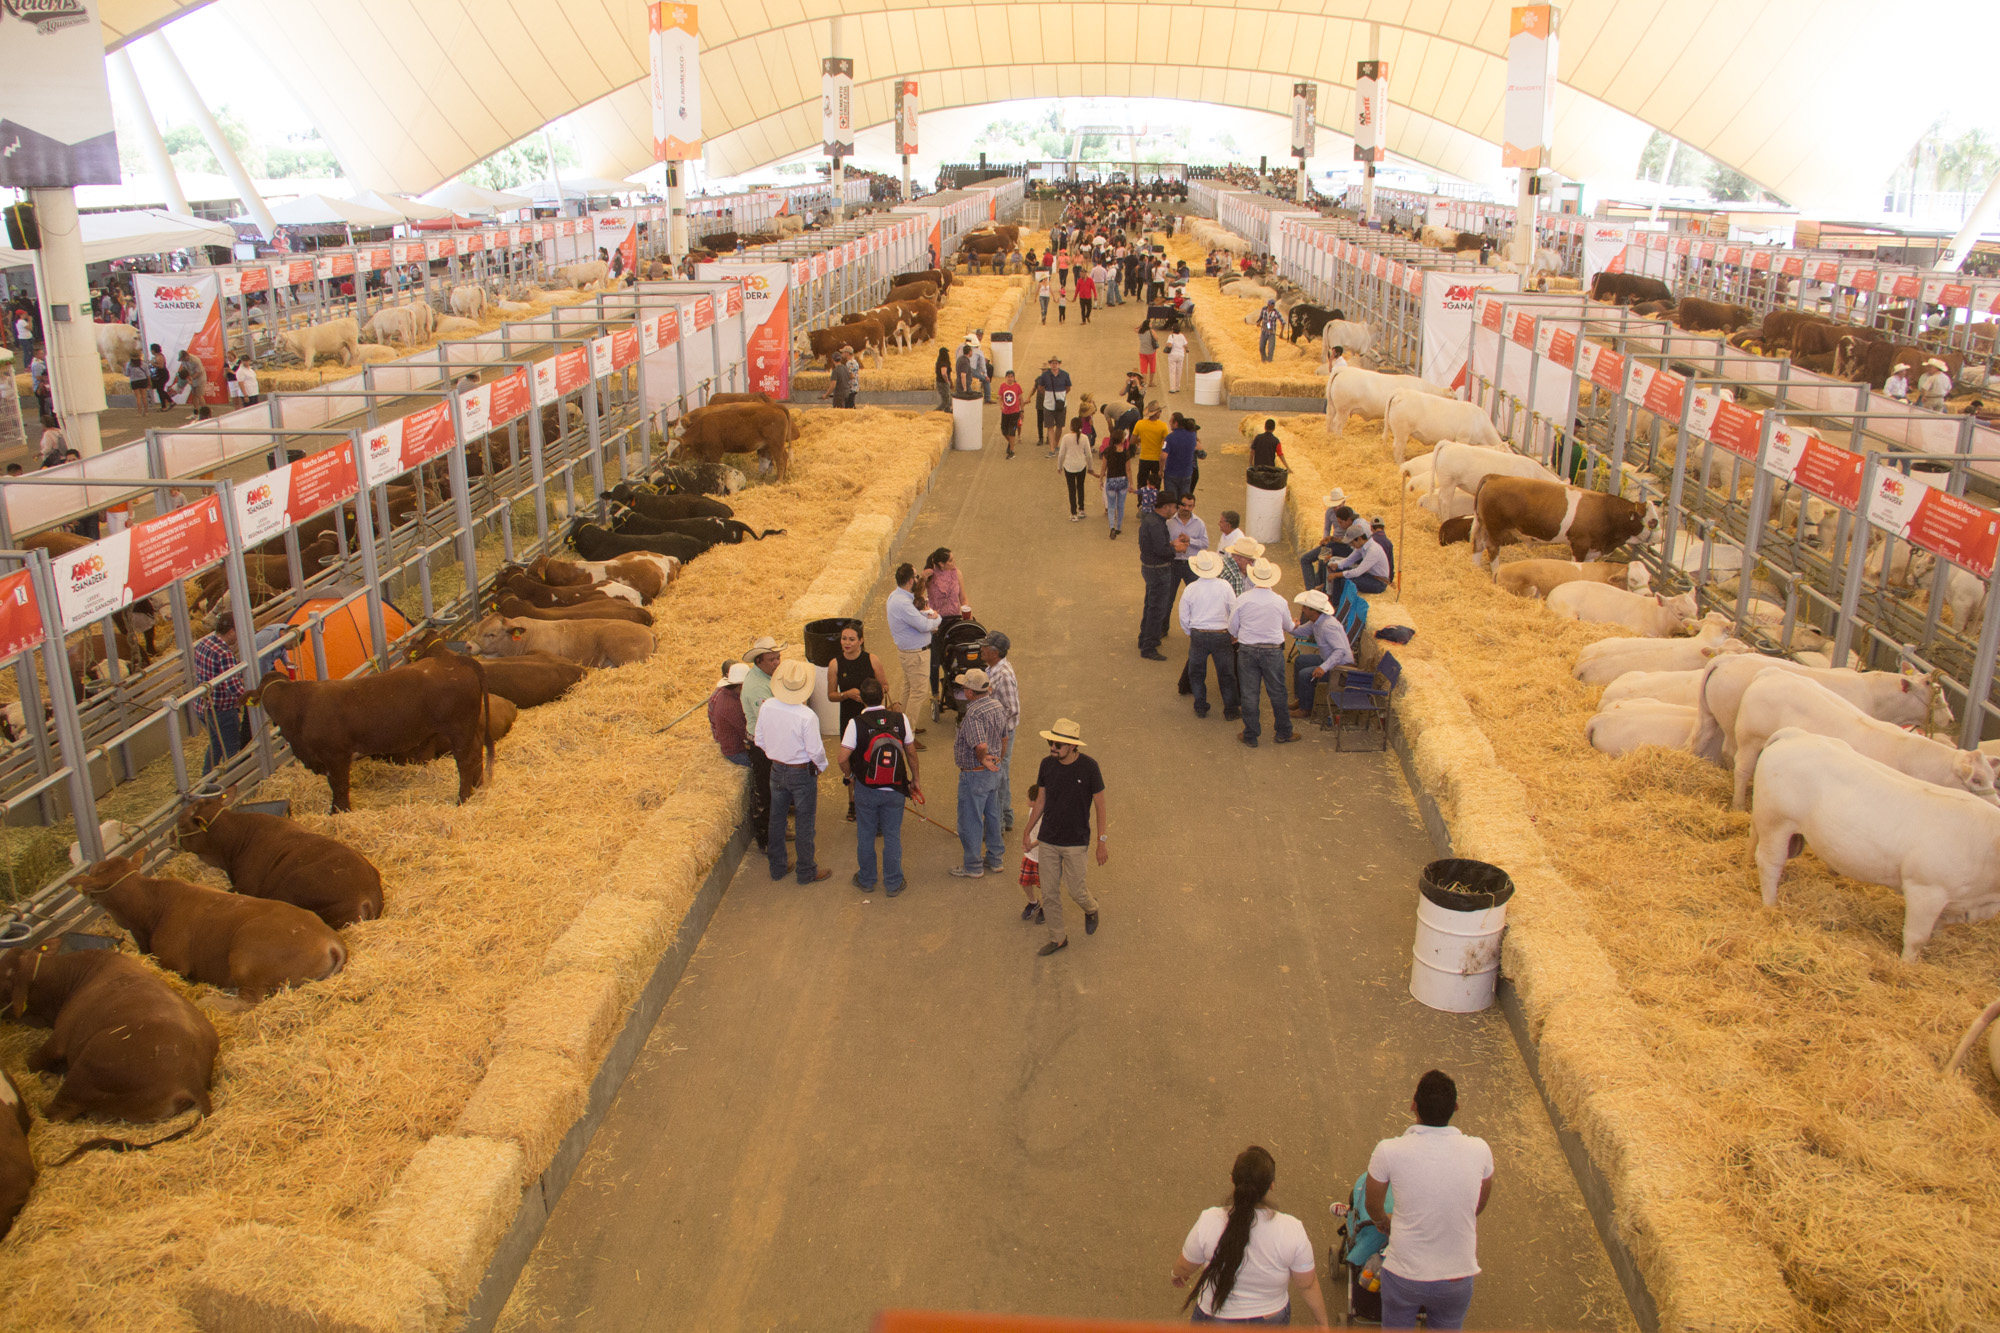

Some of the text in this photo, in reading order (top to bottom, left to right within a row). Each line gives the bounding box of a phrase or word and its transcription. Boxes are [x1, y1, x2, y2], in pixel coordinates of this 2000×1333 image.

[154, 284, 200, 301] EXPO
[157, 301, 202, 310] GANADERA
[1447, 301, 1474, 310] GANA
[1940, 494, 1958, 508] Rancho
[146, 508, 196, 534] Rancho Santa Rita
[71, 554, 105, 582] EXPO
[74, 572, 107, 592] GANADERA
[94, 597, 118, 612] GANADERA
